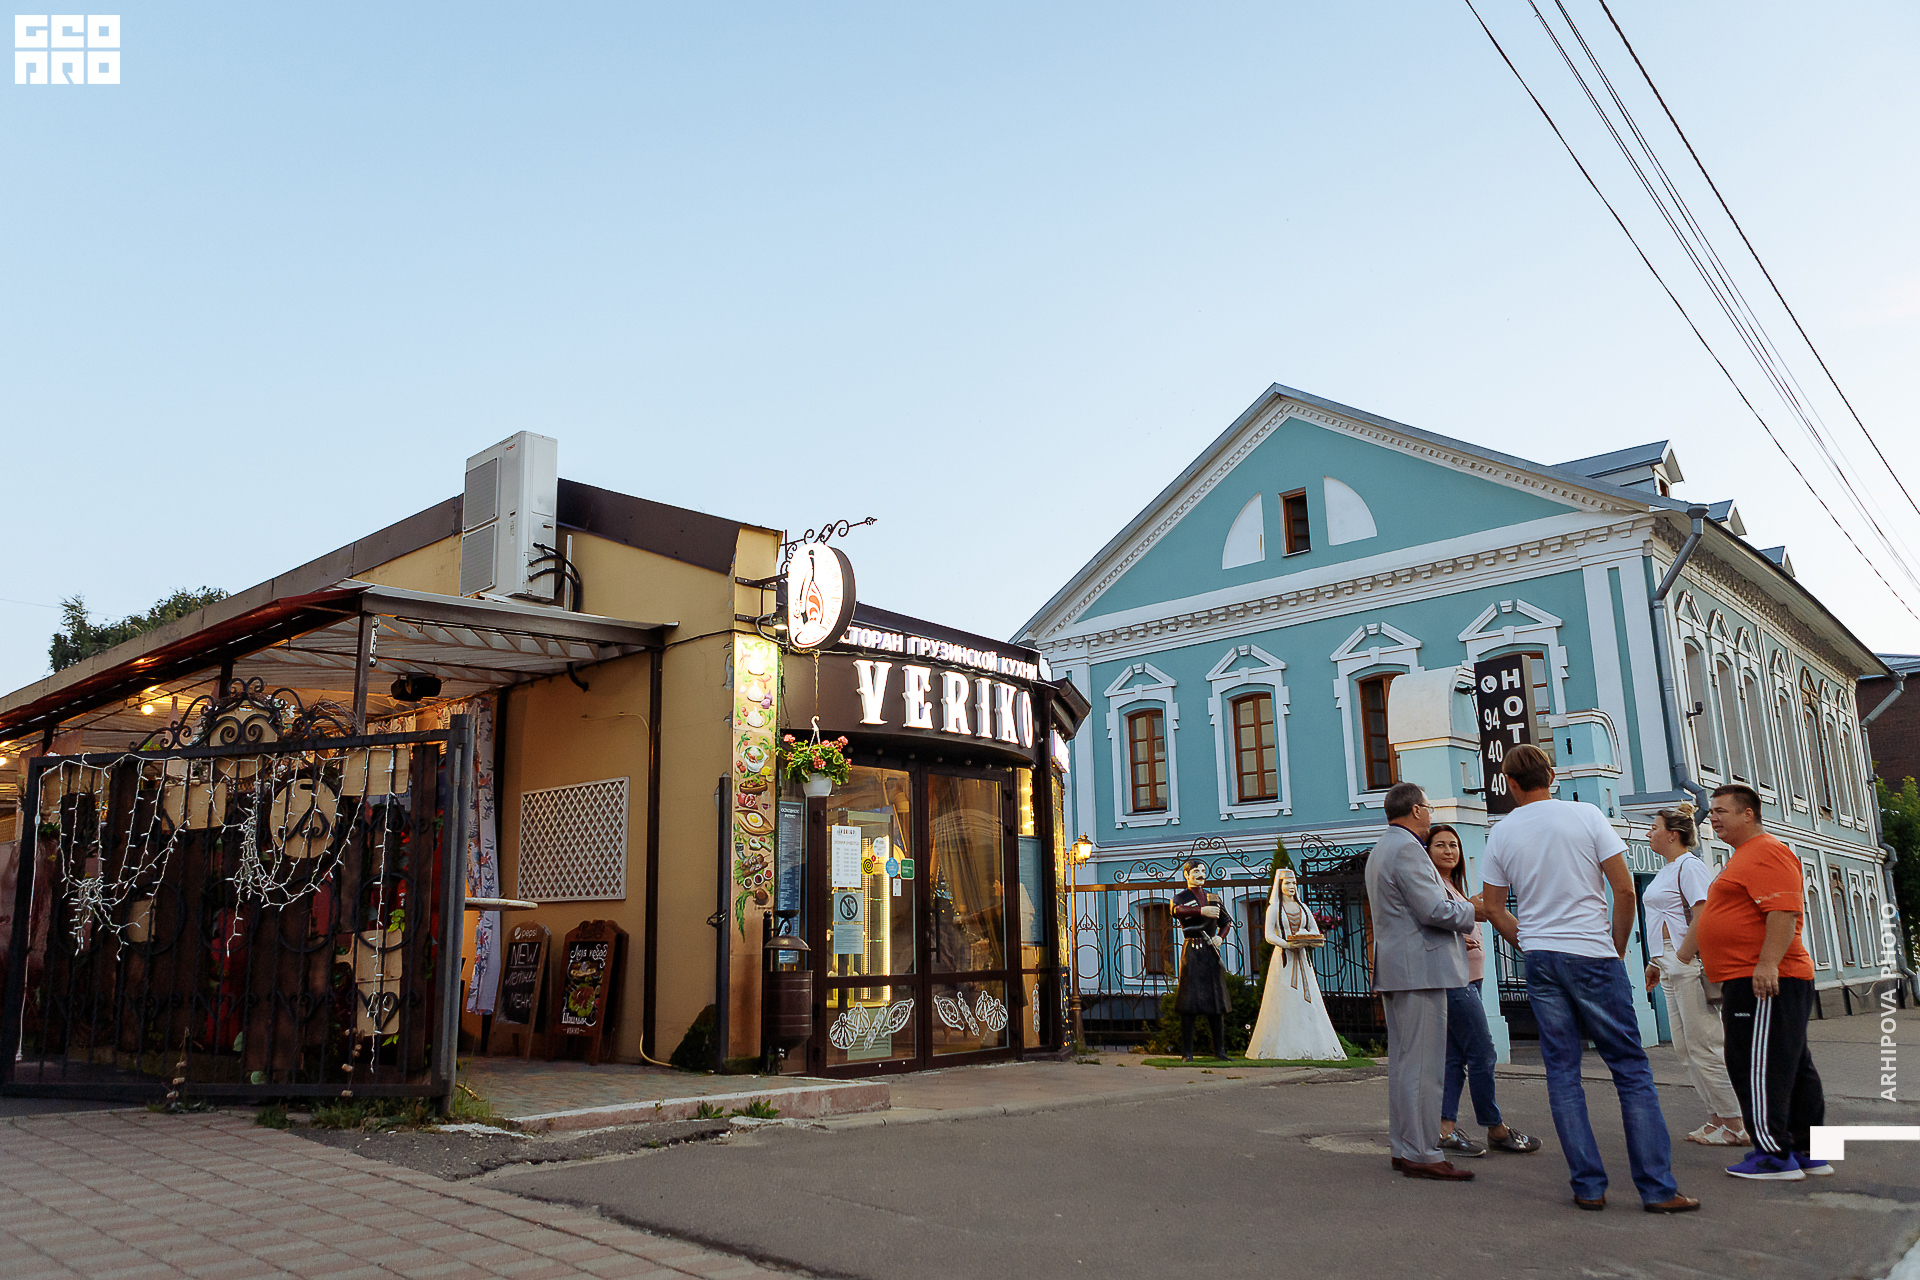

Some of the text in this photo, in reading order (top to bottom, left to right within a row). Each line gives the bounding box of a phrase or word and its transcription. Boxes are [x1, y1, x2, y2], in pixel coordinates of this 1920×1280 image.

[907, 636, 998, 672] ГРУЗИНСКОЙ
[998, 656, 1038, 681] КУХНИ
[853, 659, 1033, 749] VERIKO
[1484, 707, 1500, 731] 94
[1488, 740, 1503, 763] 40
[1491, 773, 1506, 796] 40
[521, 929, 538, 938] pepsi
[510, 943, 539, 966] NEW
